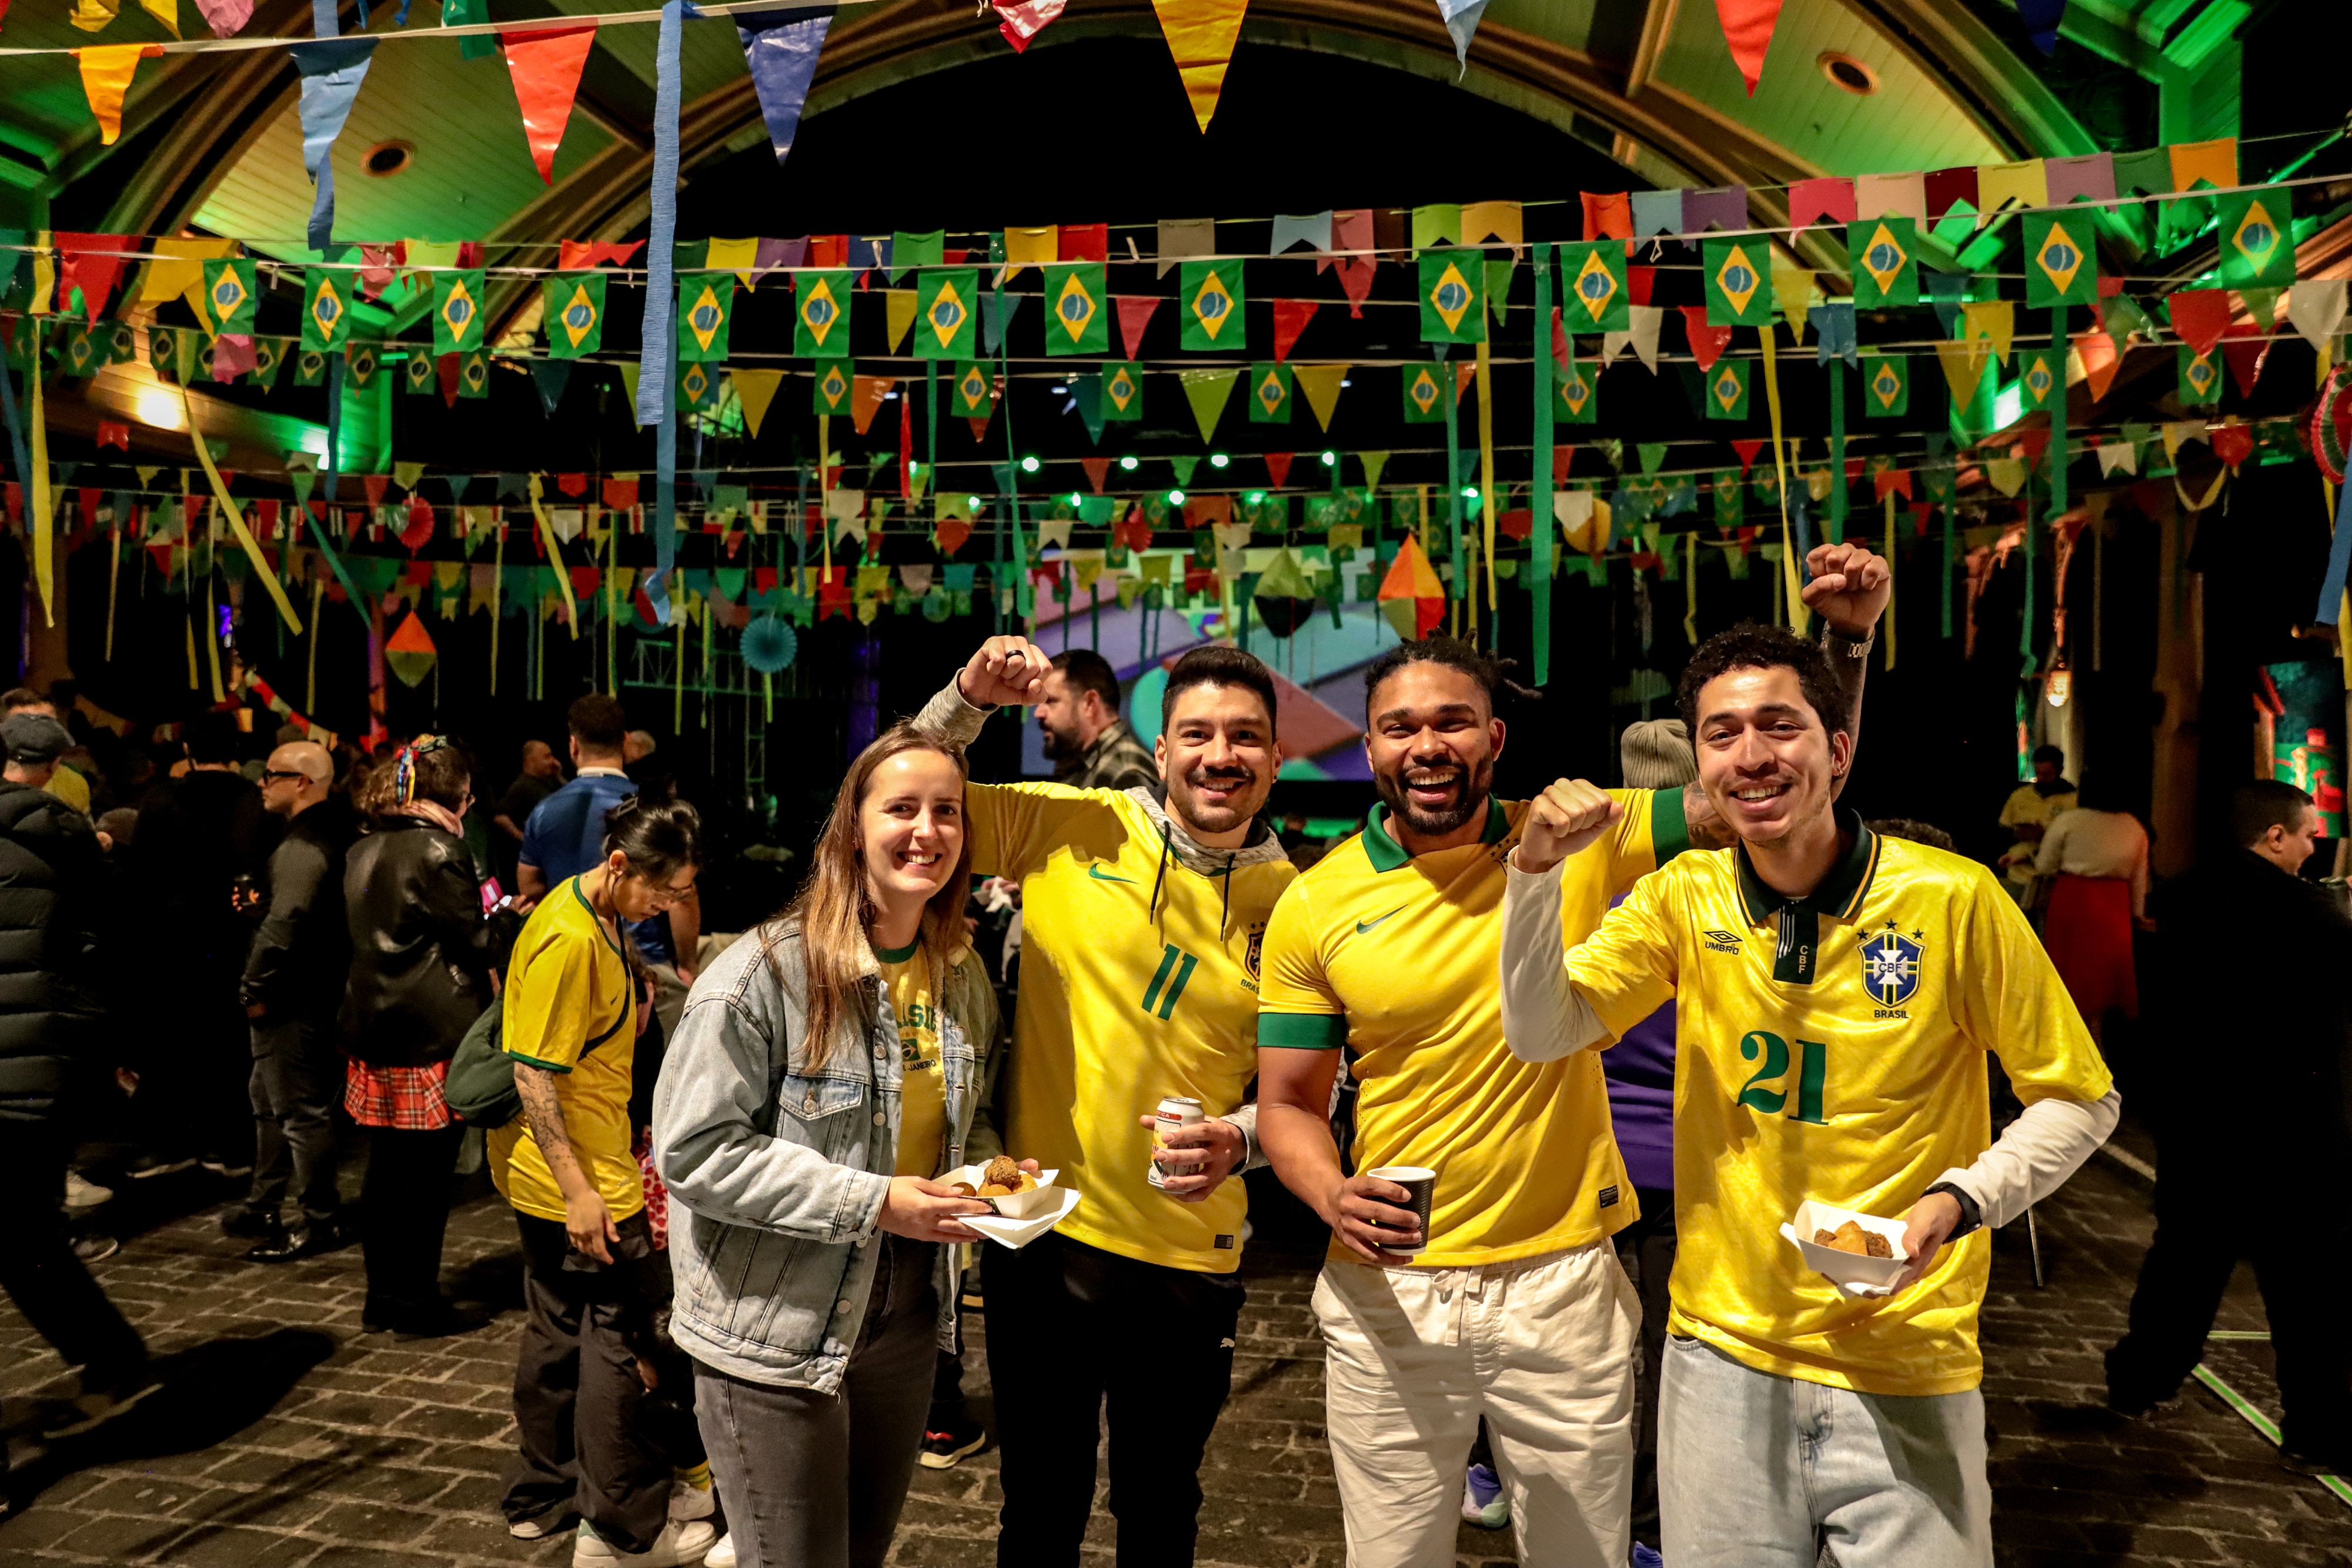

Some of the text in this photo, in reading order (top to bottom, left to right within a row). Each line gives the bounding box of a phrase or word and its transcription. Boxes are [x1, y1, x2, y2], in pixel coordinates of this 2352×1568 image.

[1705, 941, 1739, 955] UMBRO
[1799, 945, 1808, 974] CBF
[1879, 963, 1902, 973] CBF
[1141, 943, 1198, 1021] 11
[1874, 1009, 1909, 1019] BRASIL
[908, 1059, 936, 1071] JANEIRO
[1737, 1029, 1829, 1126] 21
